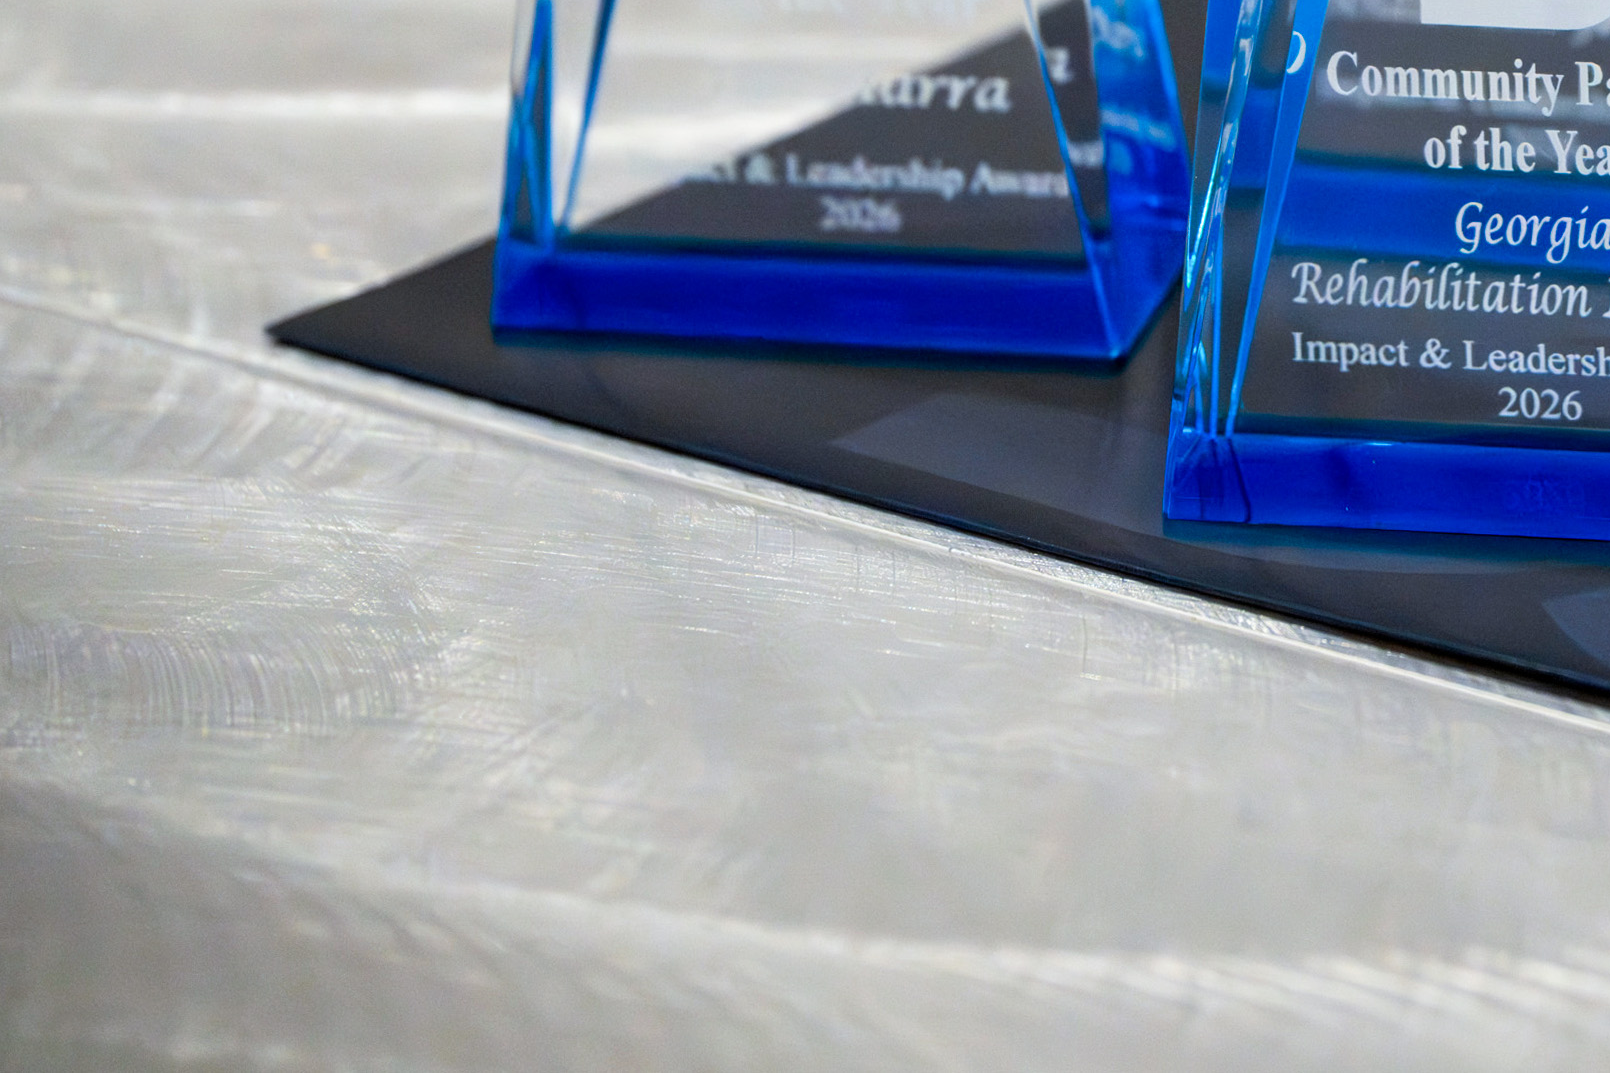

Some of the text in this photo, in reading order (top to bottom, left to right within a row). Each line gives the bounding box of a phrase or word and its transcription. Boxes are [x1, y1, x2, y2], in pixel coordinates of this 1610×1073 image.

[1326, 50, 1565, 117] Community
[1423, 125, 1468, 169] of
[1473, 127, 1537, 173] the
[820, 195, 902, 233] 2026
[1291, 257, 1593, 317] Rehabilitation
[1291, 331, 1410, 373] Impact
[1418, 338, 1453, 369] &
[1497, 386, 1584, 421] 2026
